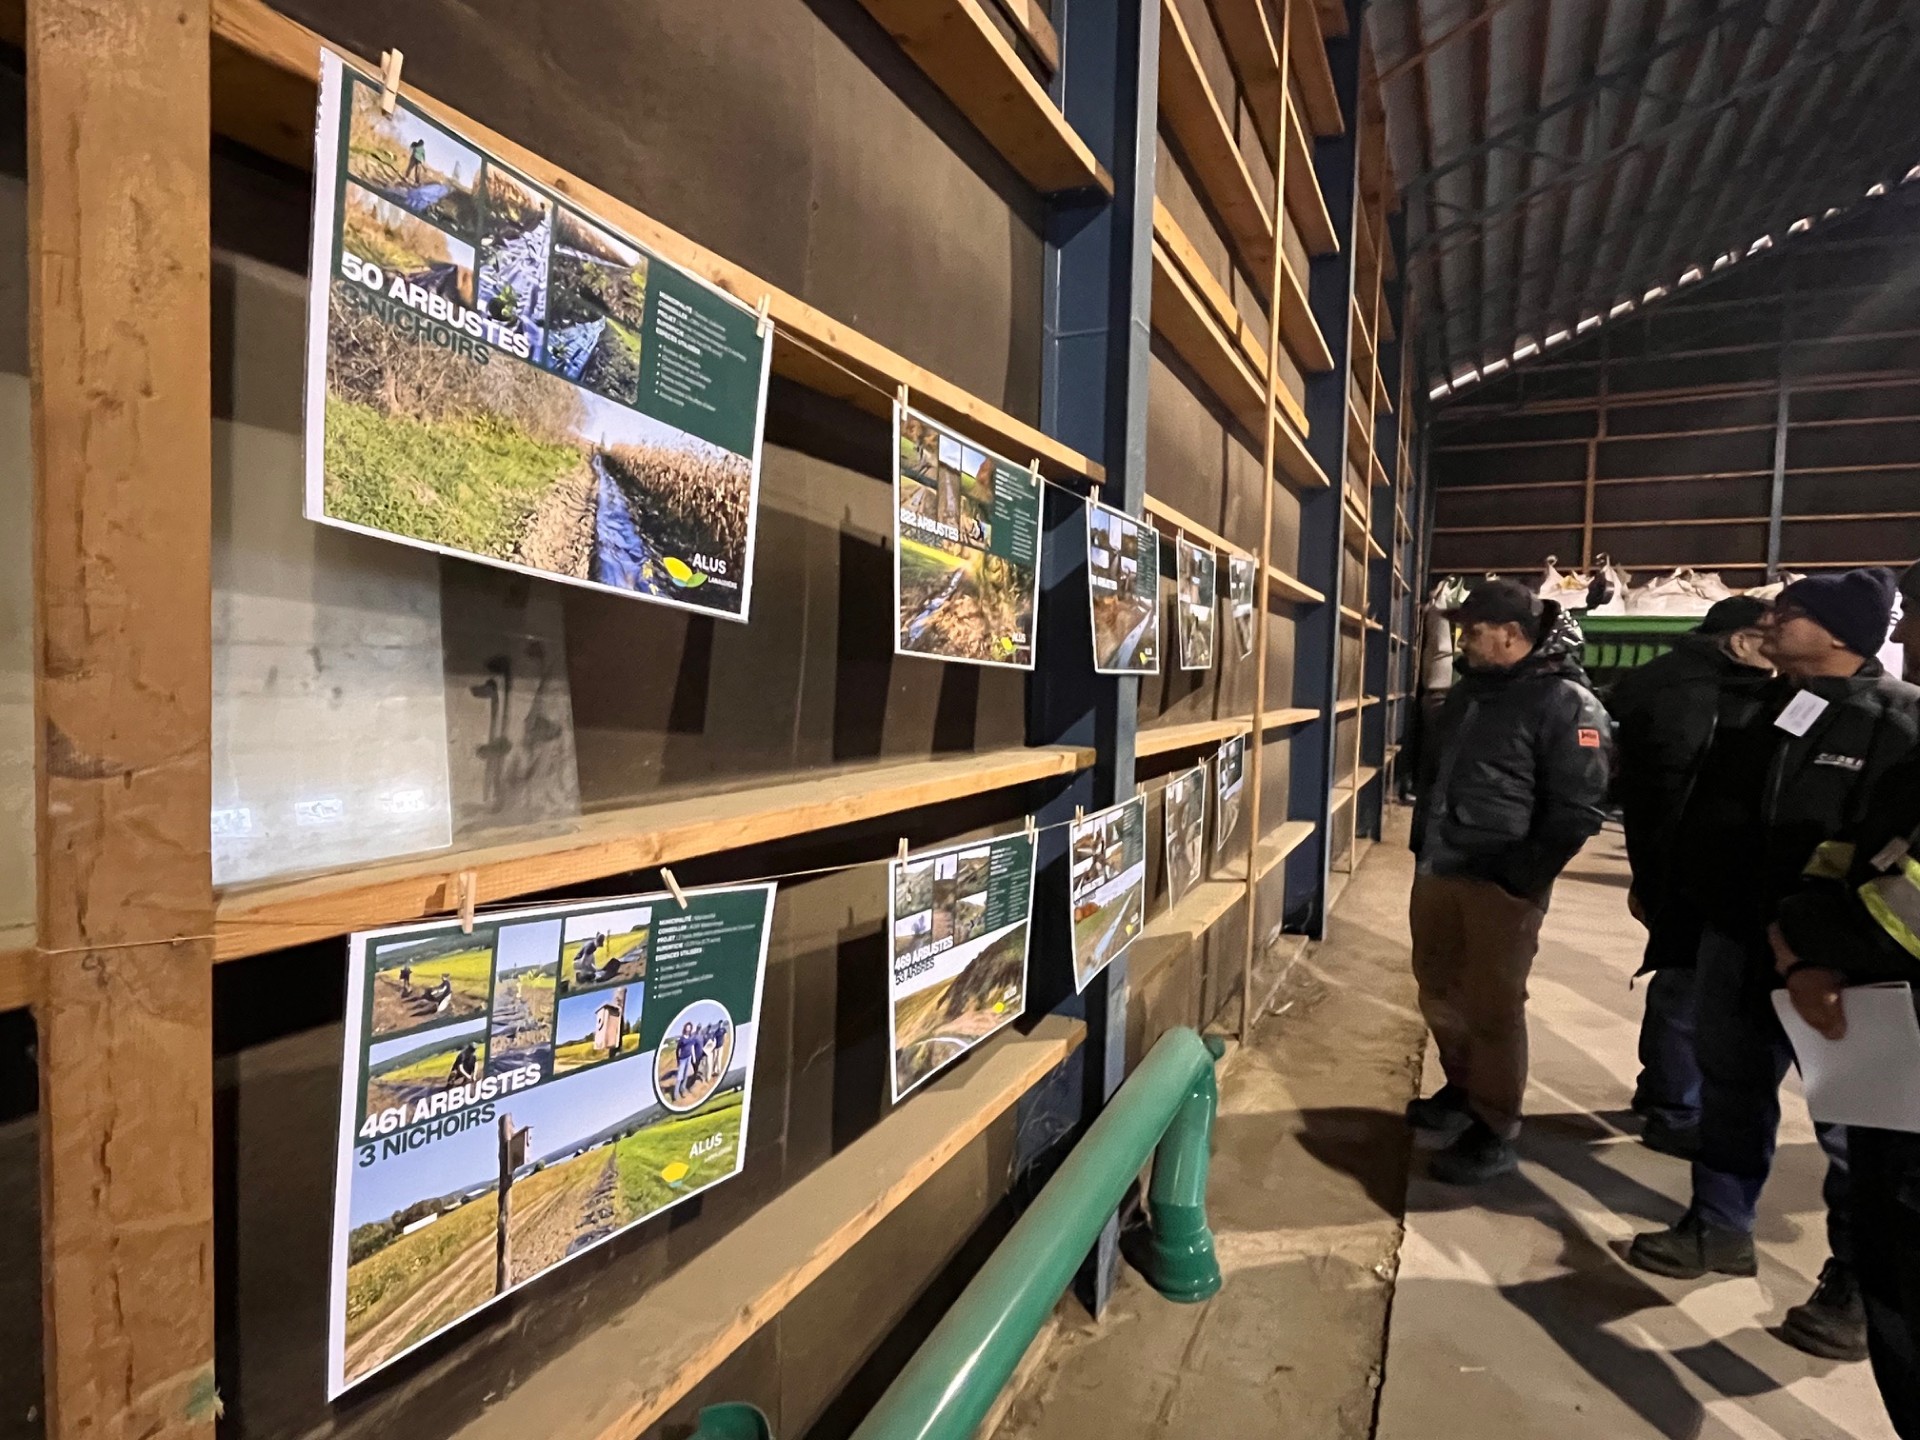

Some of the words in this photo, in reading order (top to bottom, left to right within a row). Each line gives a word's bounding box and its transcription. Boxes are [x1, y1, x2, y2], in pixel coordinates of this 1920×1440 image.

[341, 251, 383, 290] 50
[388, 276, 530, 358] ARBUSTES
[367, 297, 490, 366] NICHOIRS
[692, 553, 727, 575] ALUS
[912, 935, 954, 965] ARBUSTES
[359, 1103, 407, 1140] 461
[411, 1063, 542, 1124] ARBUSTES
[358, 1144, 377, 1169] 3
[382, 1103, 496, 1161] NICHOIRS
[689, 1132, 724, 1160] ALUS
